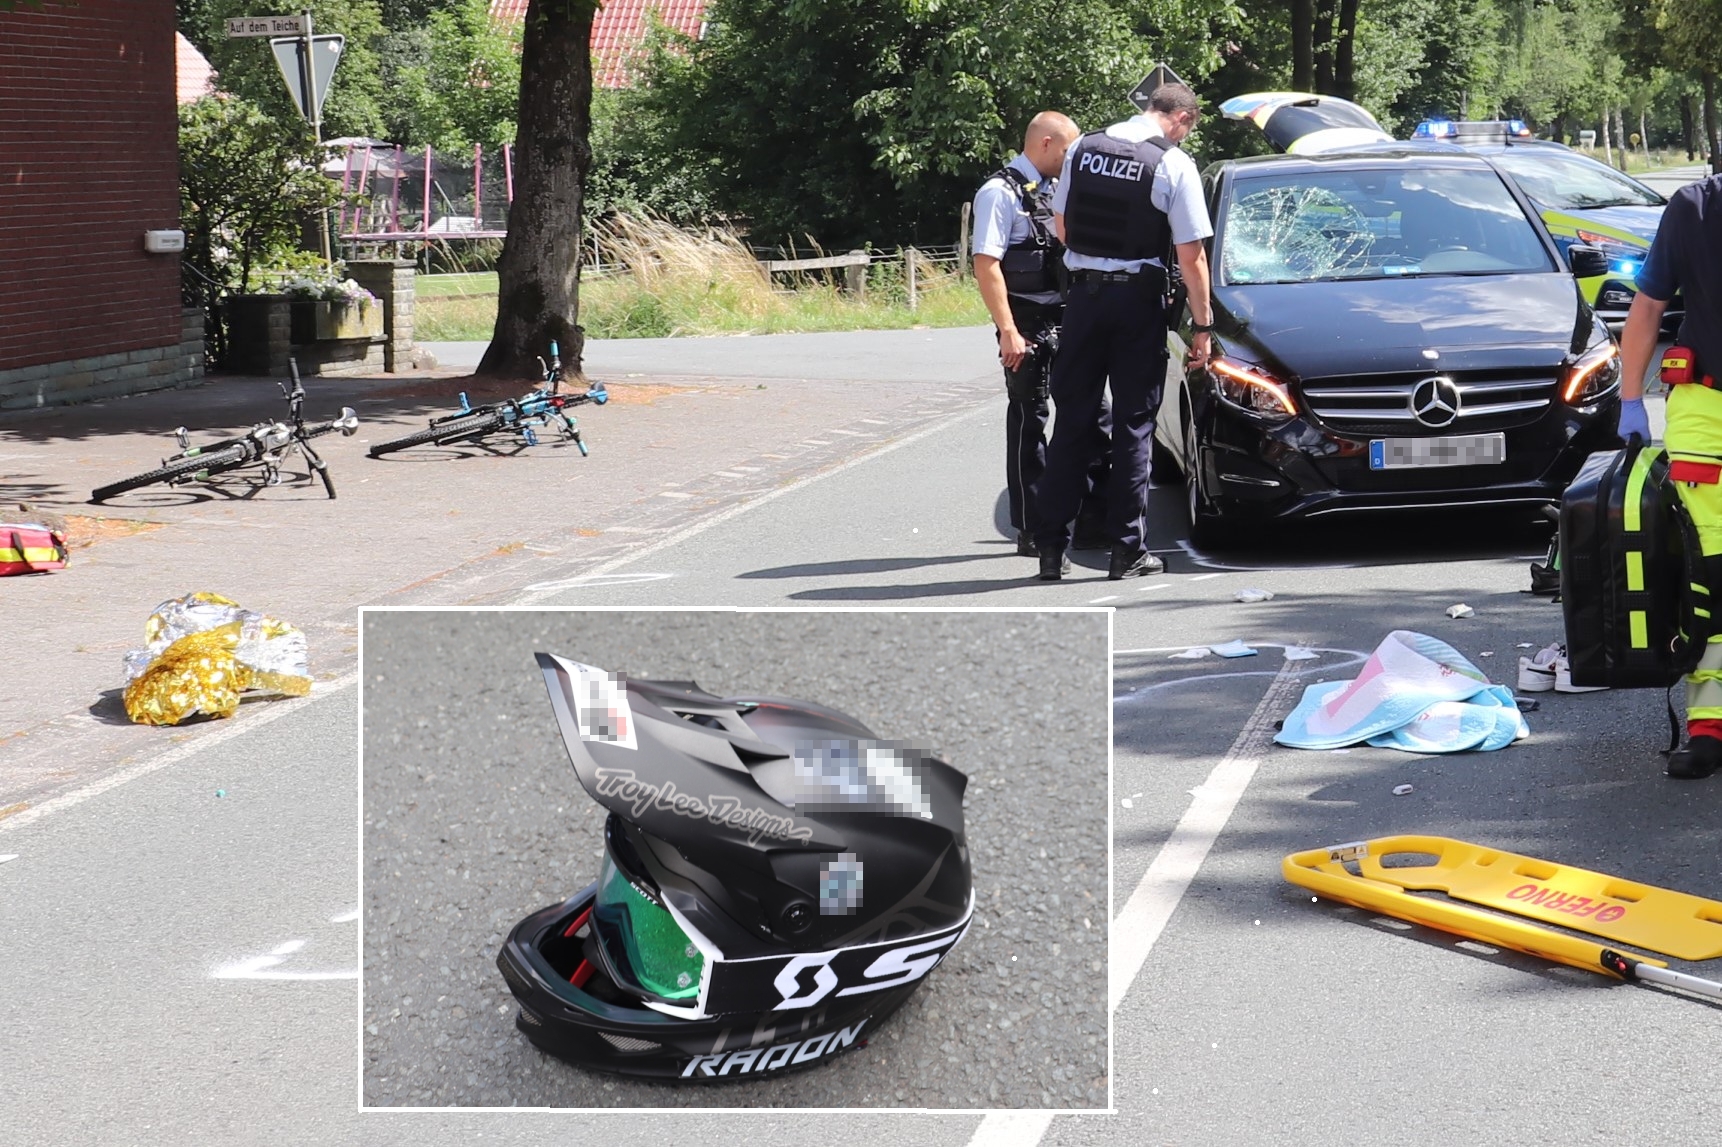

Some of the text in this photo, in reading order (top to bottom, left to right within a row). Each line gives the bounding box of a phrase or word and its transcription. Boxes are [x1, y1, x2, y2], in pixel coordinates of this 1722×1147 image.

[230, 20, 300, 33] Auf dem Teiche
[1079, 152, 1145, 182] POLIZEI
[595, 767, 812, 847] Troy Lee Designs
[630, 881, 659, 905] SCOTT
[1505, 884, 1608, 918] FERNO
[681, 1018, 871, 1077] RADON
